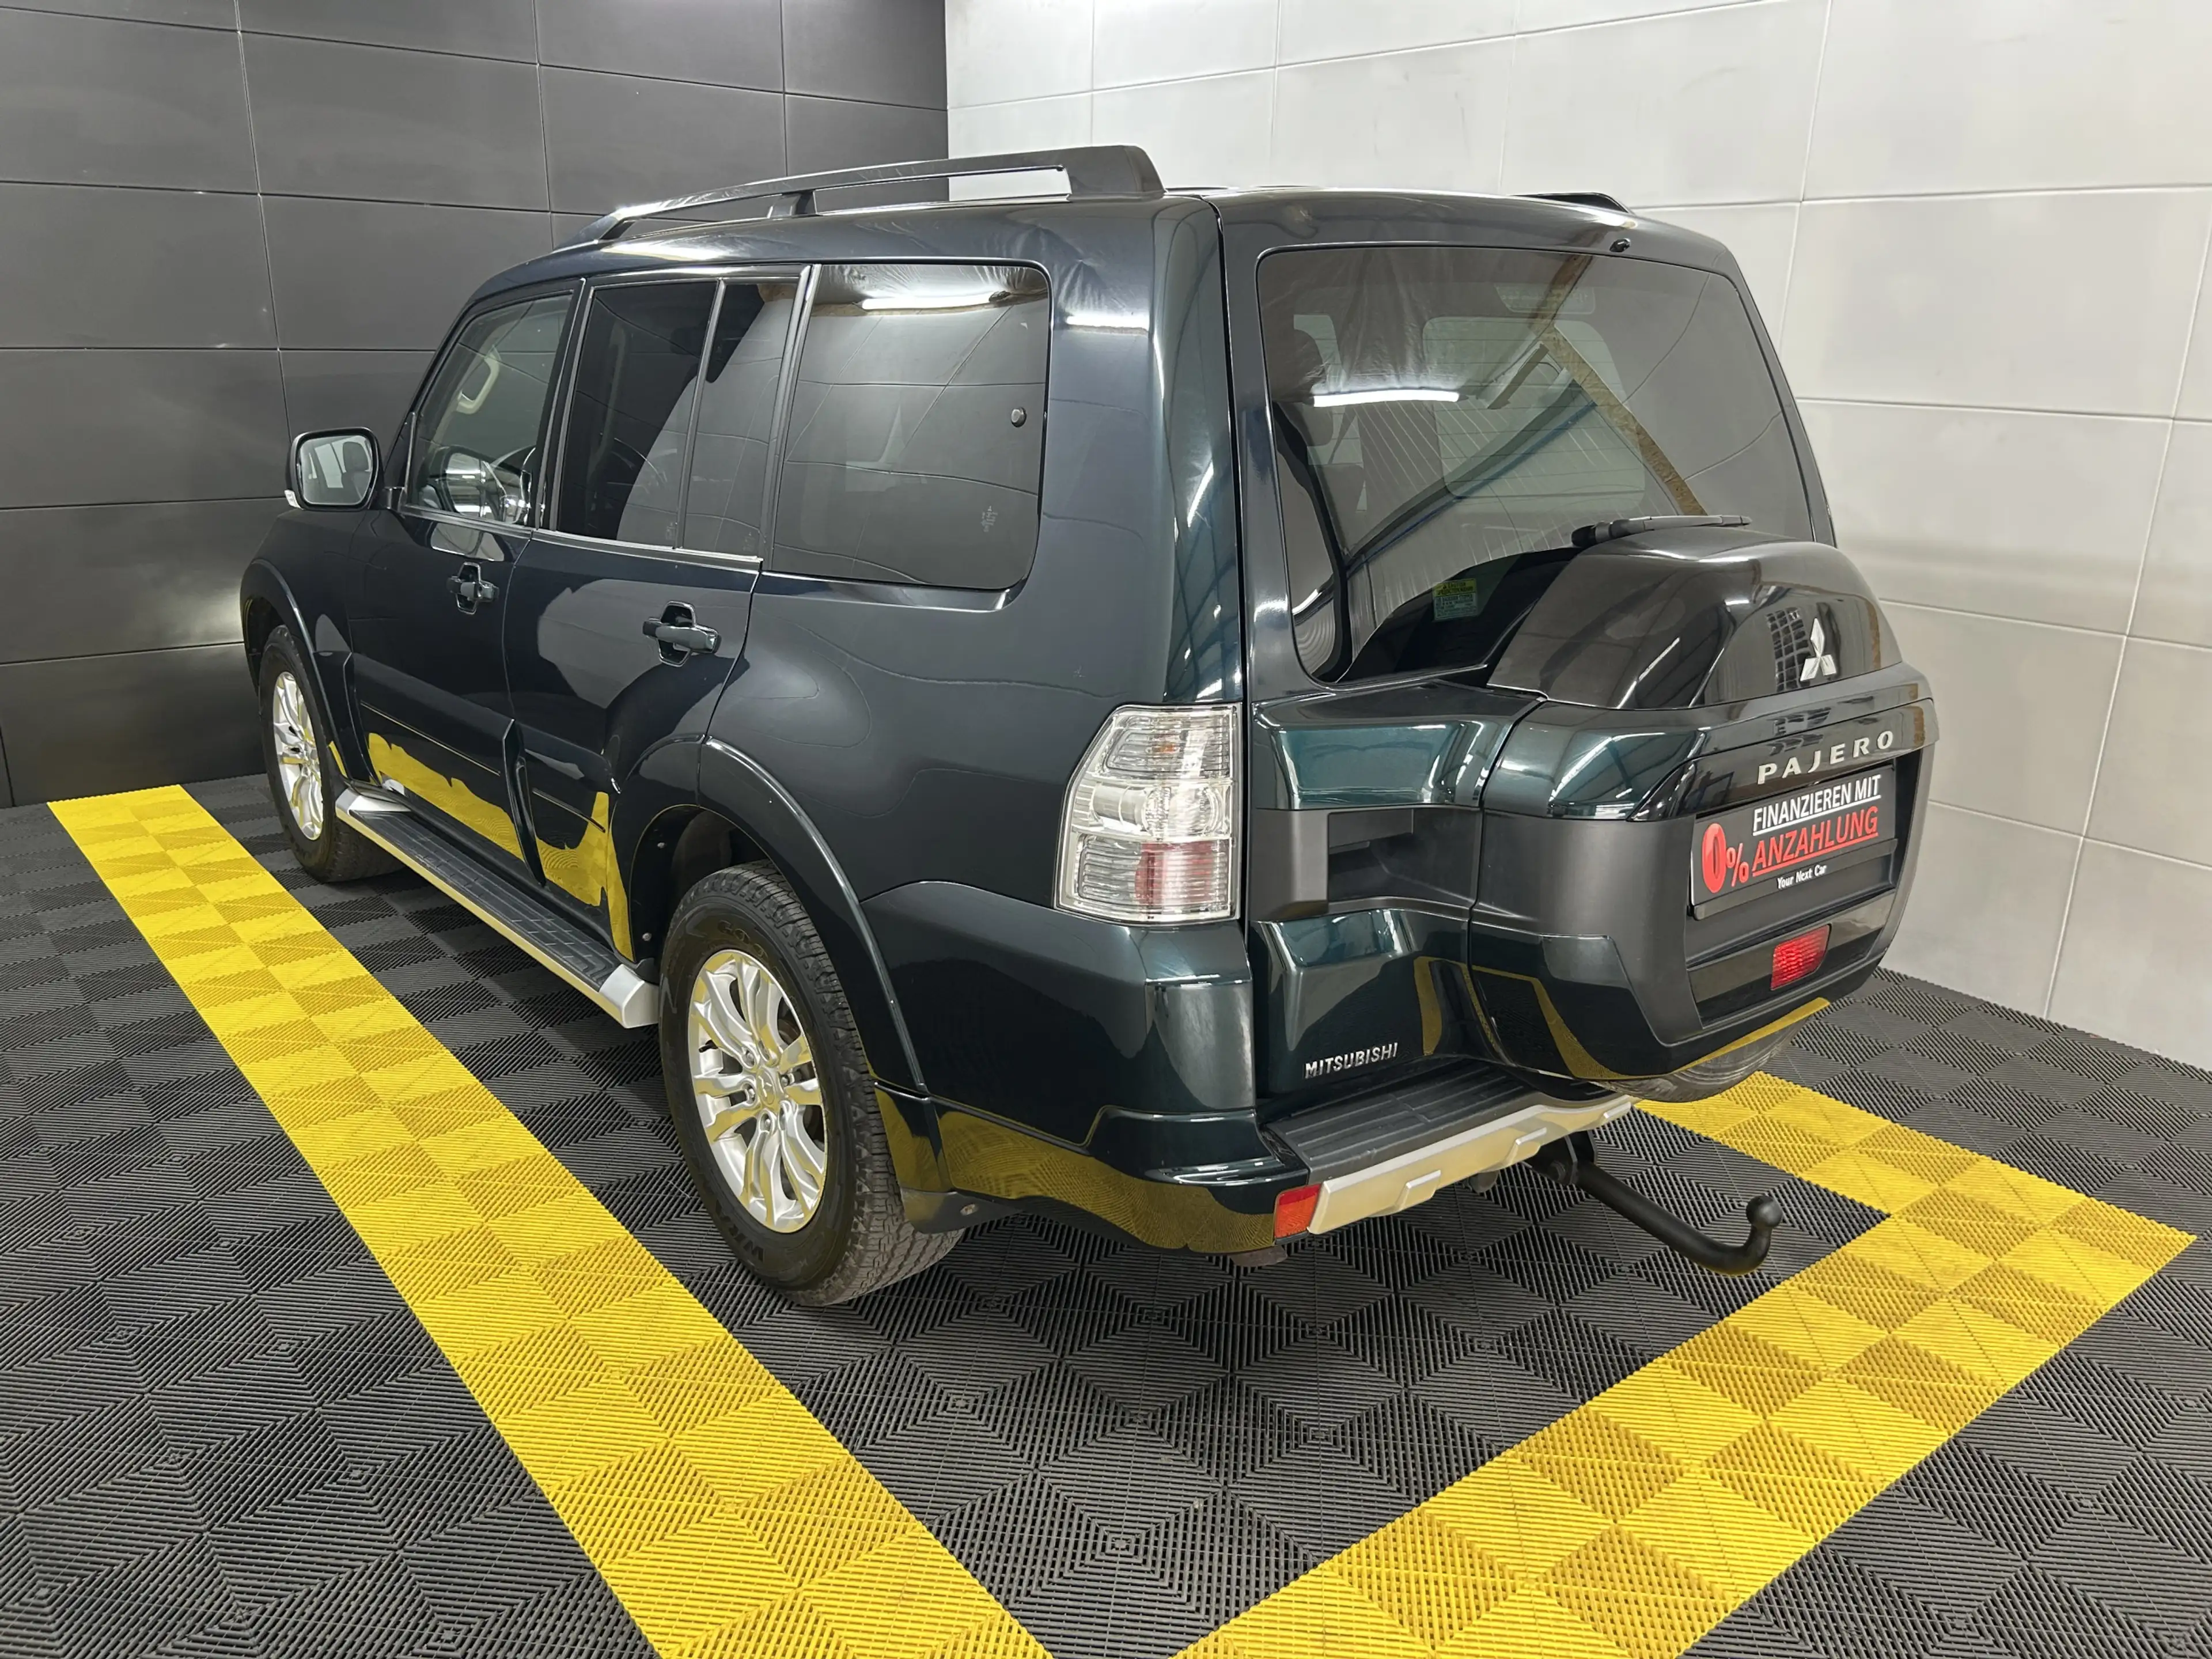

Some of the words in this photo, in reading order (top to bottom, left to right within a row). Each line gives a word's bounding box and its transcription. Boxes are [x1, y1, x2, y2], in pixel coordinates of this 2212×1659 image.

[1757, 730, 1893, 785] PAJERO
[1752, 782, 1852, 832] FINANZIEREN
[1854, 774, 1881, 801] MIT
[1702, 823, 1750, 893] 0%
[1751, 805, 1878, 872] ANZAHLUNG
[1777, 876, 1794, 889] Your
[1796, 870, 1813, 883] Next
[1814, 864, 1827, 876] Car
[1304, 1041, 1399, 1080] MITSUBISHI
